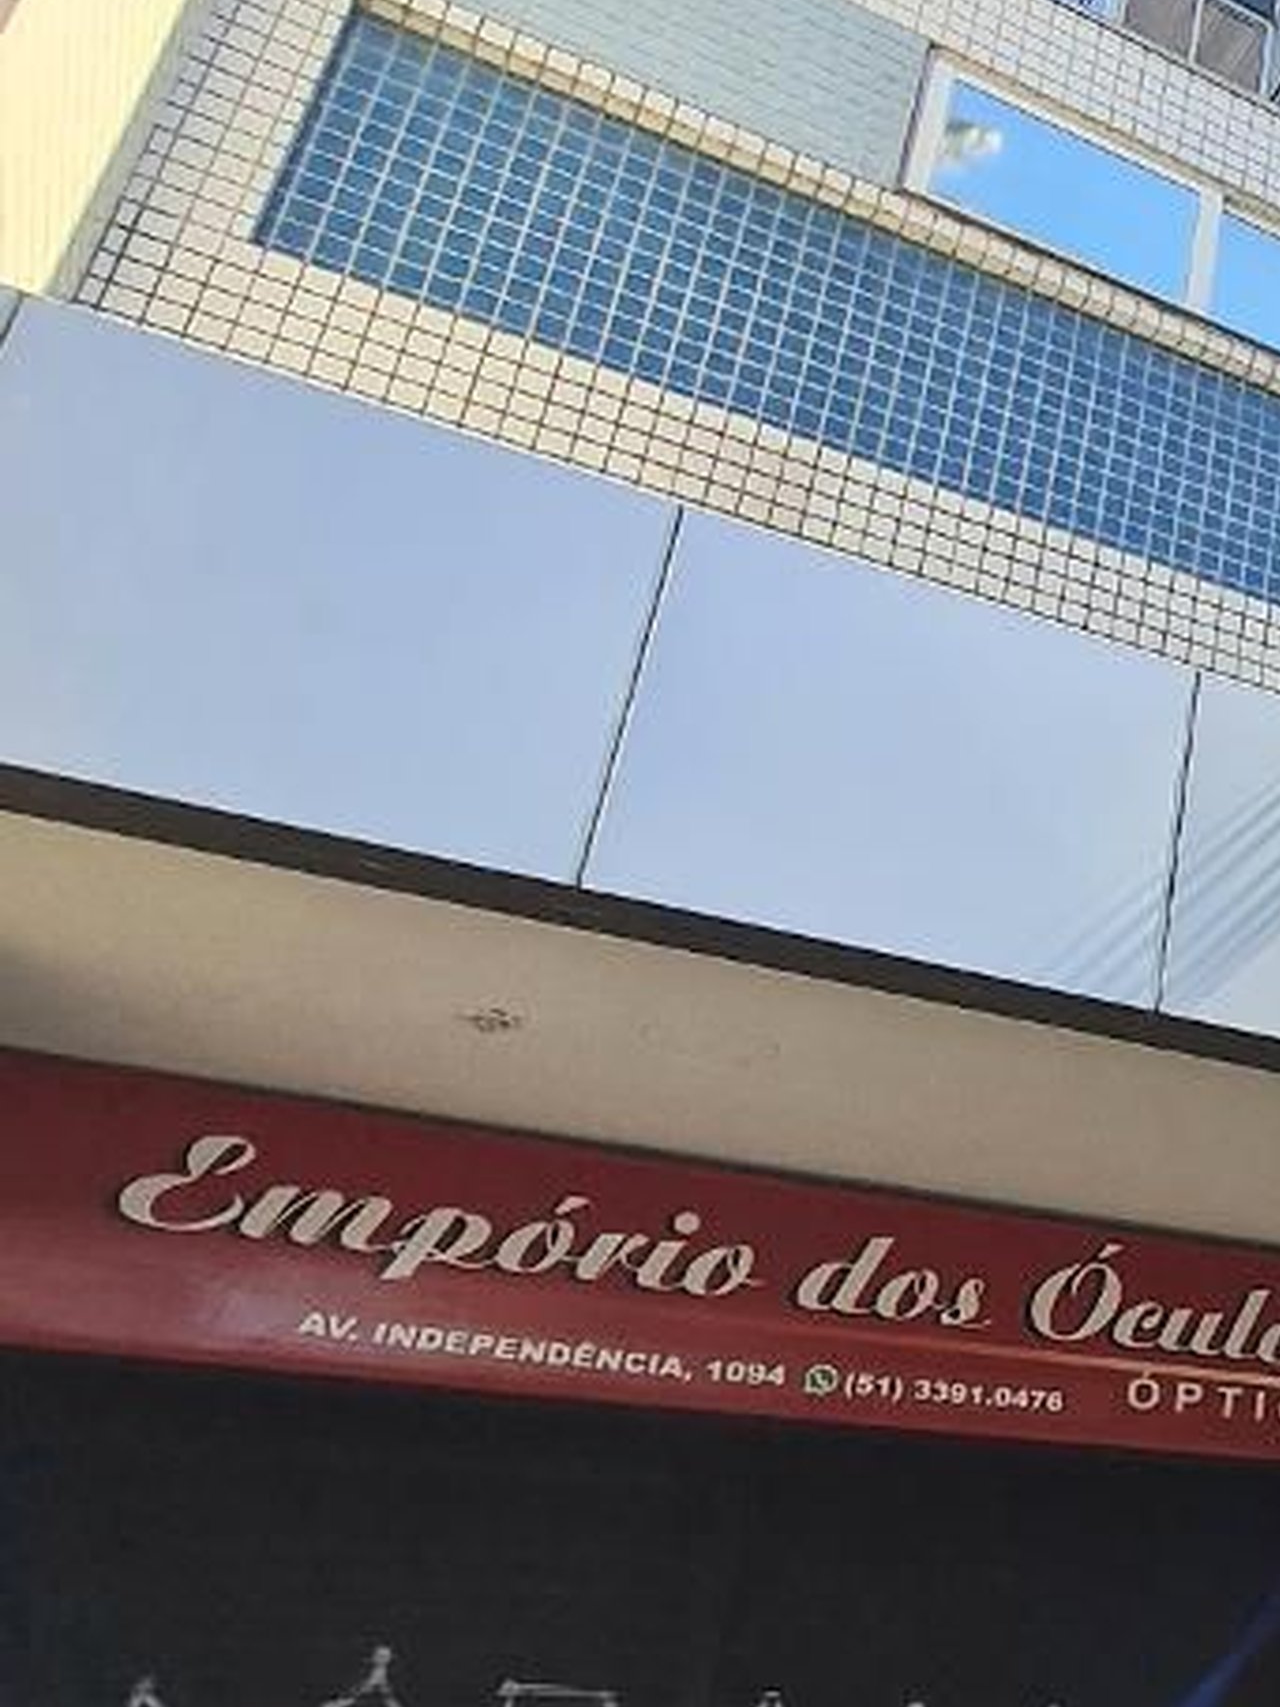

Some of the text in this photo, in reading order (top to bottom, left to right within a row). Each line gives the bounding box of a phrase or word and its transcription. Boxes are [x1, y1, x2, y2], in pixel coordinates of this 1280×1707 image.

[118, 1133, 762, 1297] Empório
[798, 1236, 992, 1328] dos
[299, 1311, 1064, 1413] AV. INDEPENDÊNCIA, 1094 (51) 3391.0476
